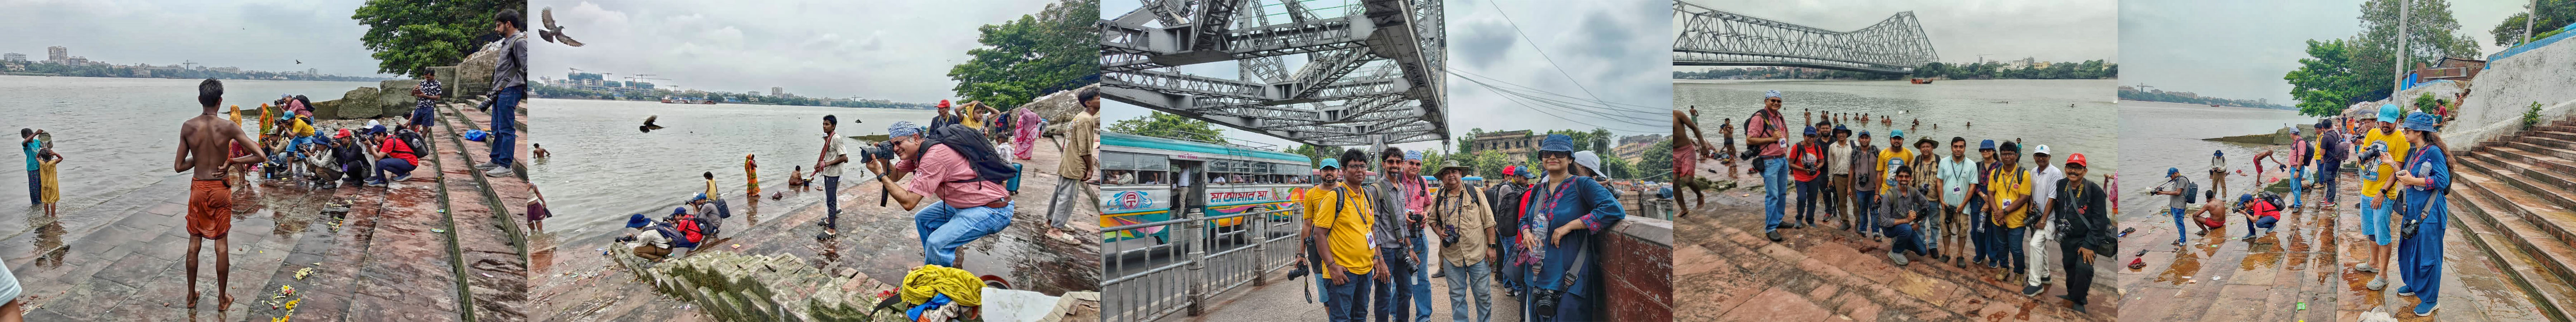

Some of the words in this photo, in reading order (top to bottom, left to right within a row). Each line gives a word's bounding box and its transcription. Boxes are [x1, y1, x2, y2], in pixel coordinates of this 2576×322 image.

[1210, 192, 1224, 203] মা
[1223, 191, 1256, 202] আমার
[1257, 191, 1268, 200] মা
